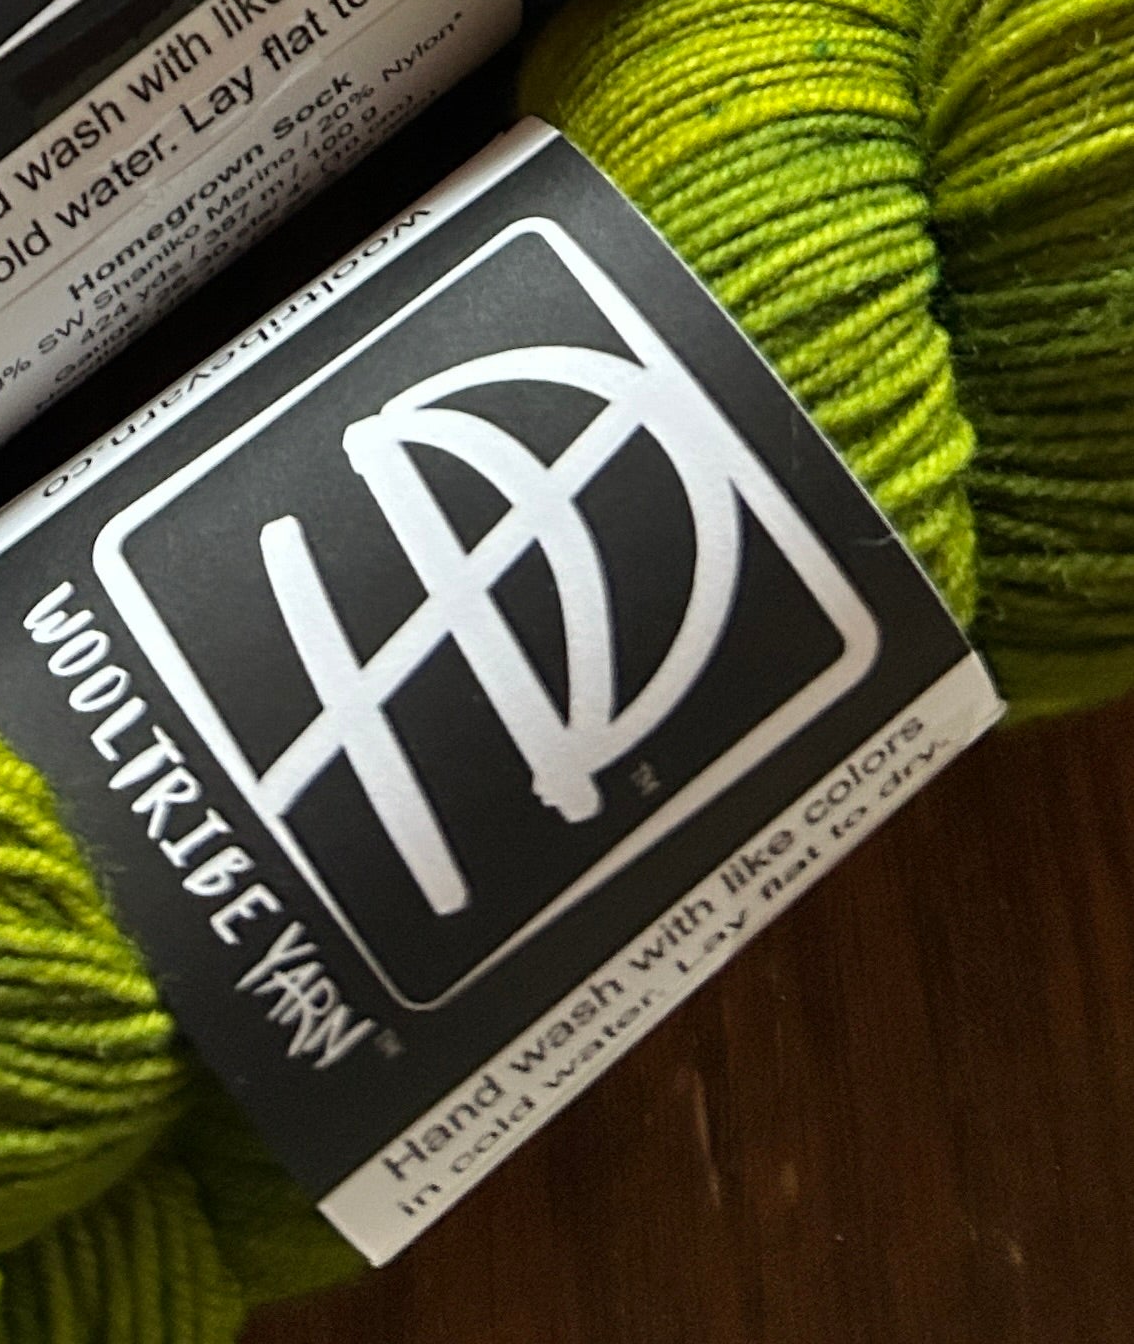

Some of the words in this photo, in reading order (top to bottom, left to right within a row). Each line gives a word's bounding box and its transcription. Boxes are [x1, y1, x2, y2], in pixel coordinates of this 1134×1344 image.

[13, 101, 126, 192] wash
[126, 32, 213, 103] with
[37, 309, 84, 355] SW
[92, 223, 201, 311] Shaniko
[205, 147, 296, 222] Merino
[316, 84, 375, 135] 20%
[54, 132, 178, 229] water.
[178, 65, 255, 134] Lay
[261, 8, 328, 72] flat
[67, 143, 265, 302] Homegrown
[272, 73, 353, 141] Sock
[22, 581, 281, 945] WOOLTRIBE
[235, 921, 374, 1068] YARN
[382, 1074, 506, 1181] Hand
[508, 978, 625, 1075] wash
[628, 899, 716, 972] with
[719, 829, 795, 895] like
[804, 715, 924, 826] colors
